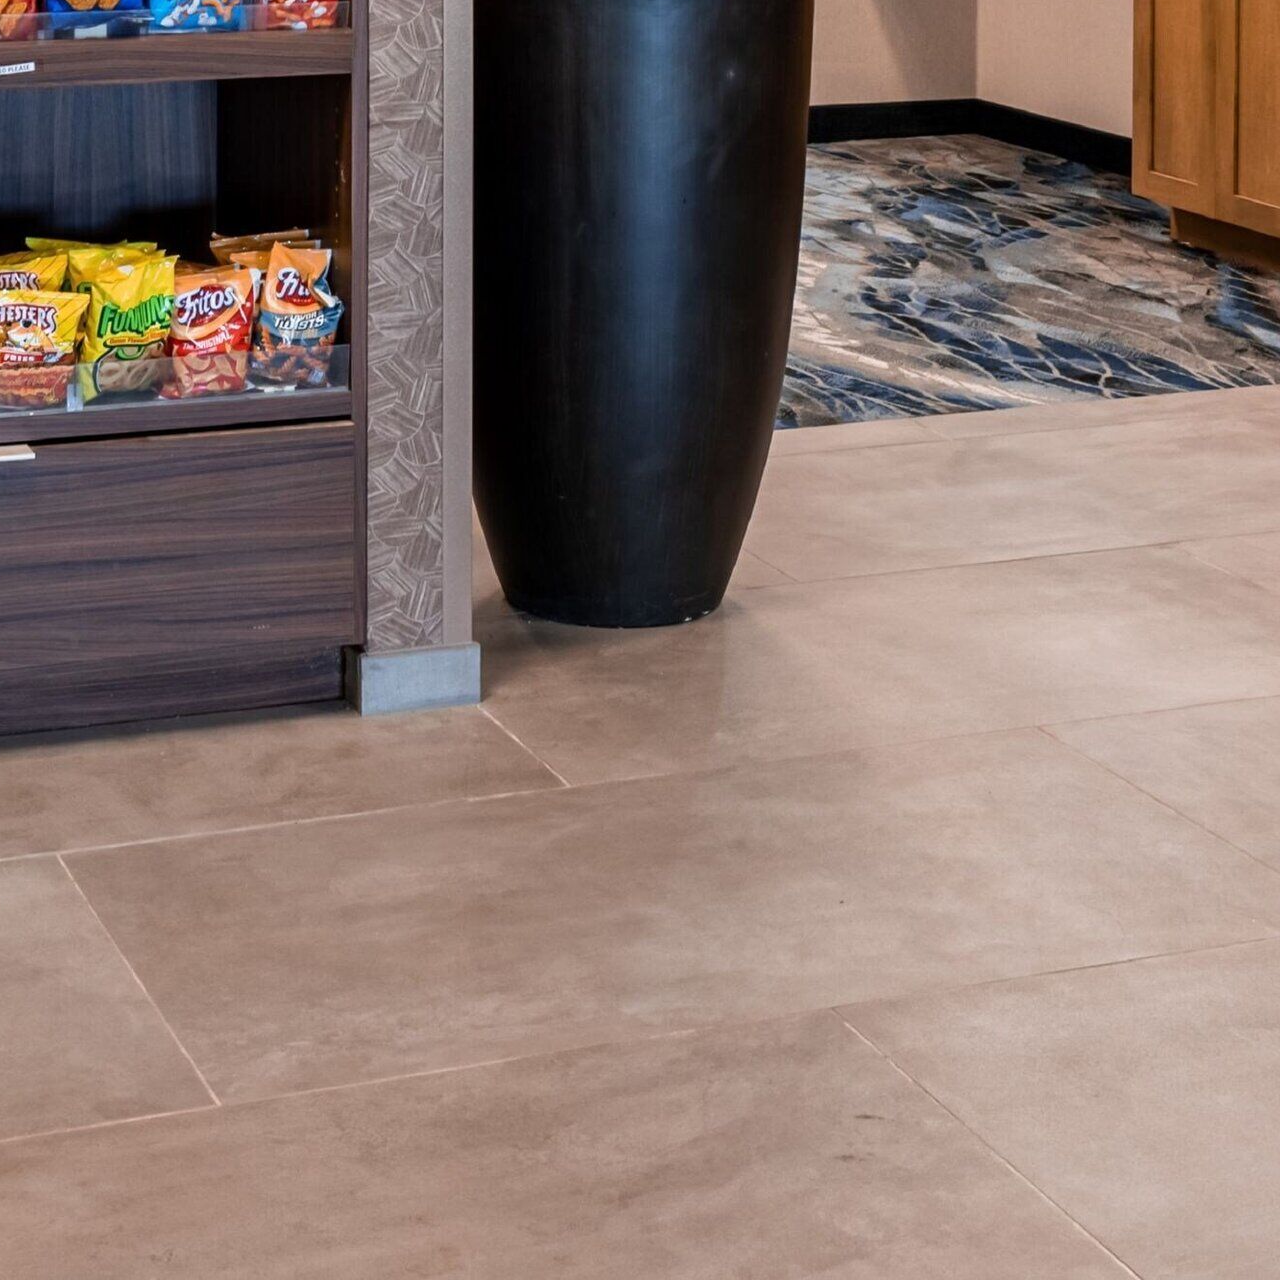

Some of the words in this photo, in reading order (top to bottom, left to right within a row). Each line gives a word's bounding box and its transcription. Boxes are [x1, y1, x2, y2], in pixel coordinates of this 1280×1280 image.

[7, 64, 30, 74] PLEASE
[175, 286, 235, 324] Fritos
[3, 353, 35, 362] FRIES
